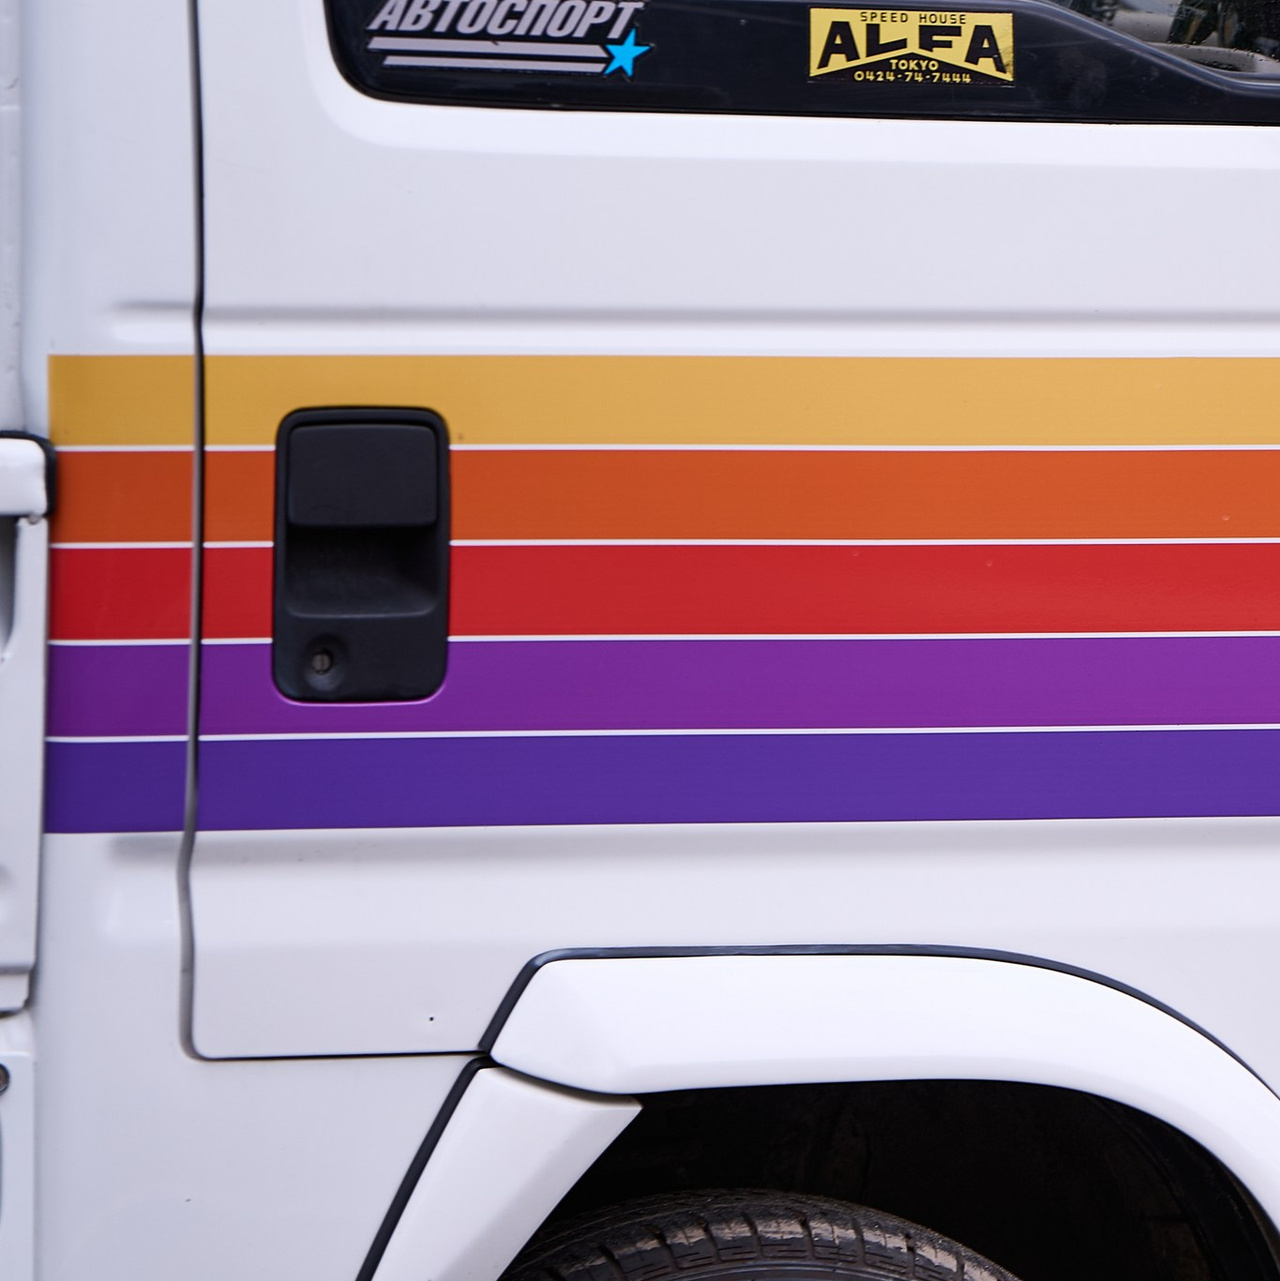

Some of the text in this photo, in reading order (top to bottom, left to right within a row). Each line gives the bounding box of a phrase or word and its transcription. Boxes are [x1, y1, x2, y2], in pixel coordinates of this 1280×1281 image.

[860, 11, 967, 25] SPEED HOUSE
[816, 20, 1008, 75] ALFA
[889, 59, 940, 71] TOKYO
[853, 70, 973, 83] 0424-74-7444
